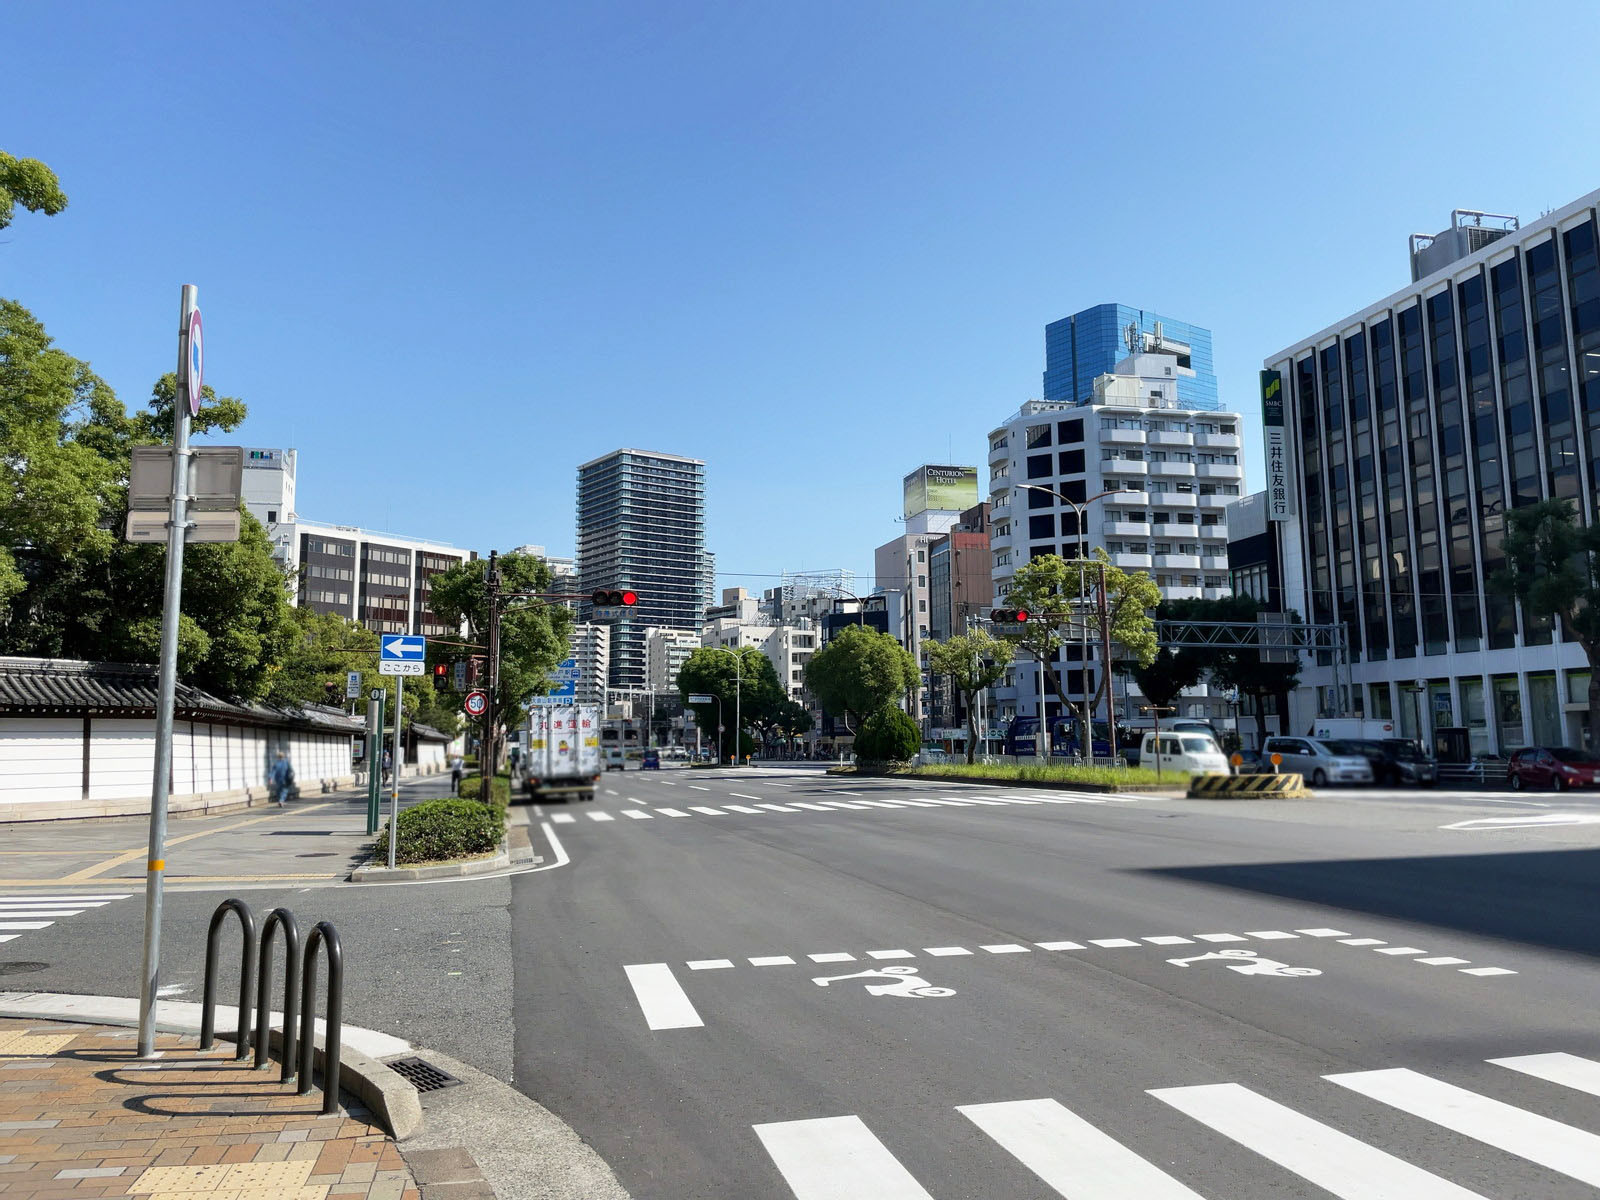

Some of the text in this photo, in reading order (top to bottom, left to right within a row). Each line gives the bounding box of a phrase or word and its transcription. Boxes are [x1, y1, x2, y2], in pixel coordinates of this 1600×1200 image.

[927, 468, 964, 477] CENTURION
[1270, 432, 1286, 514] 三井住友銀行
[383, 663, 421, 673] ここから
[470, 698, 483, 709] 50
